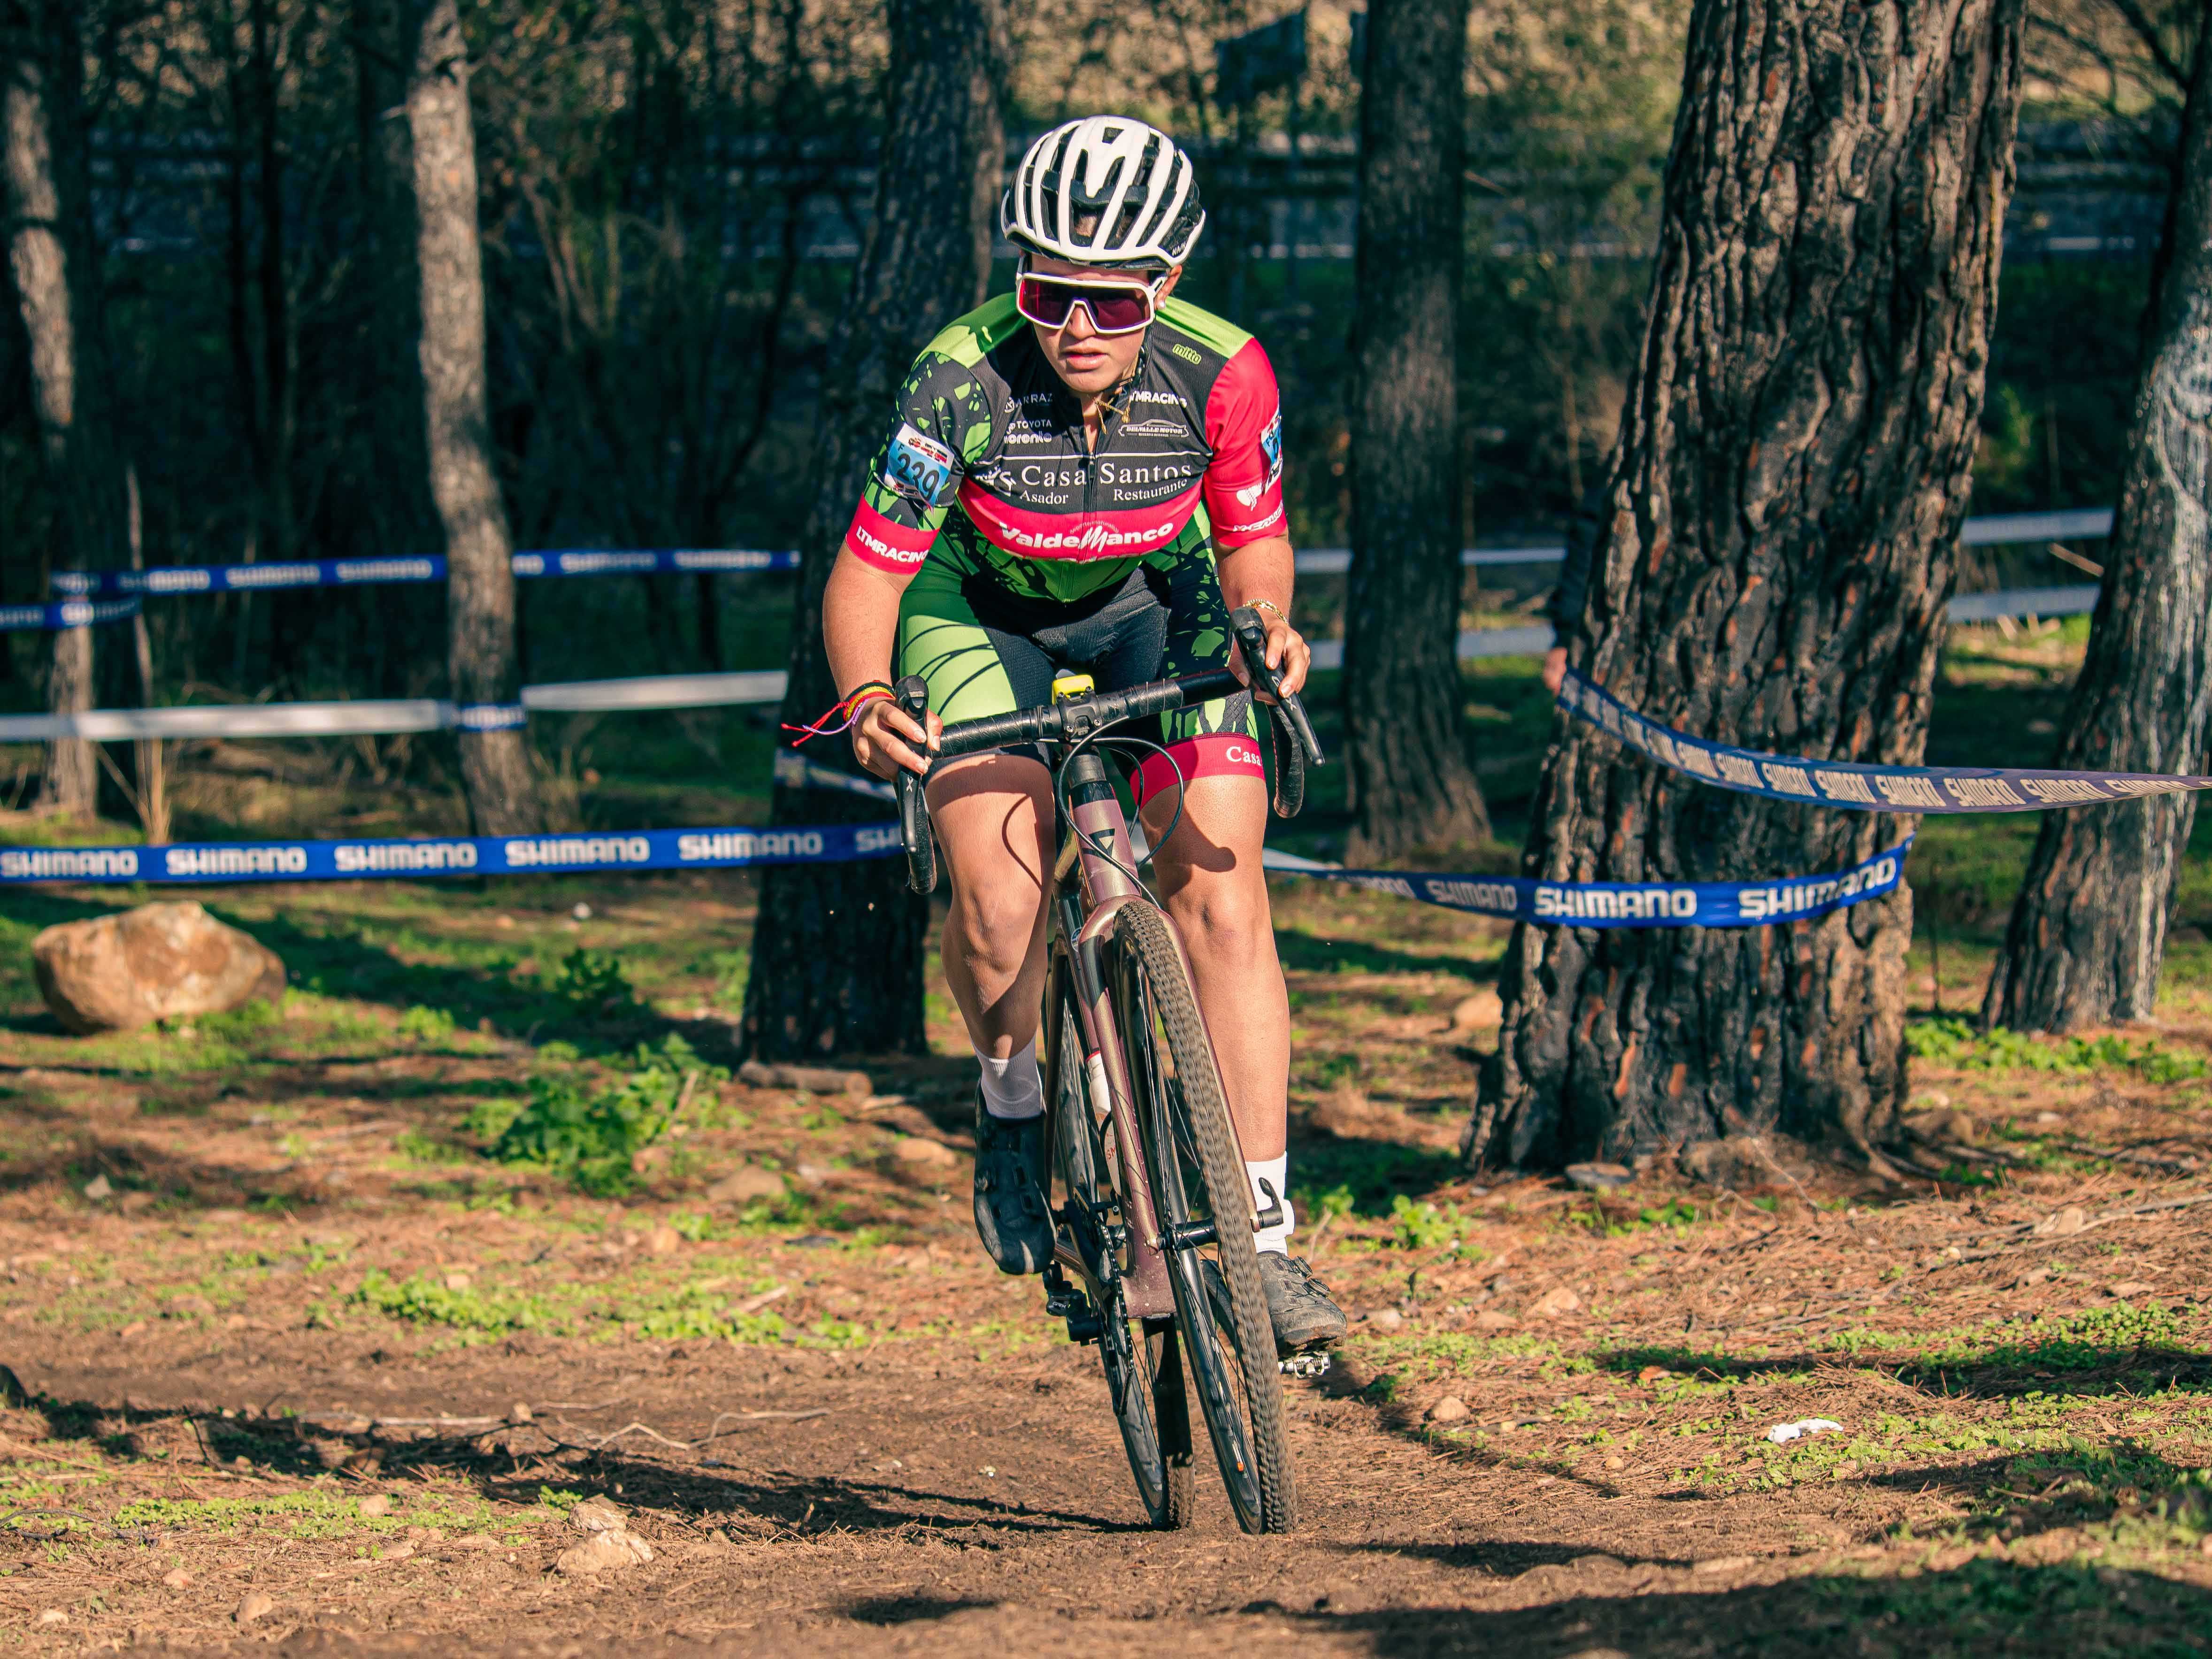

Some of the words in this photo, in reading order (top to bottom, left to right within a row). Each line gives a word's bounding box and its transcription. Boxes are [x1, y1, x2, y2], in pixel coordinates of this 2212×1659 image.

[1173, 344, 1201, 364] mitto
[1017, 420, 1052, 429] TOYOTA
[1022, 465, 1087, 487] Casa
[1100, 462, 1191, 484] Santos
[1019, 490, 1069, 504] Asador
[1113, 479, 1187, 501] Restaurante
[1226, 746, 1261, 767] Casa
[2, 850, 138, 877] SHIMANO
[165, 847, 307, 876] SHIMANO
[334, 843, 477, 872] SHIMANO
[505, 837, 650, 867] SHIMANO
[677, 832, 822, 861] SHIMANO
[1426, 880, 1518, 911] SHIMANO
[1534, 886, 1697, 918] SHIMANO
[1738, 857, 1896, 918] SHIMANO
